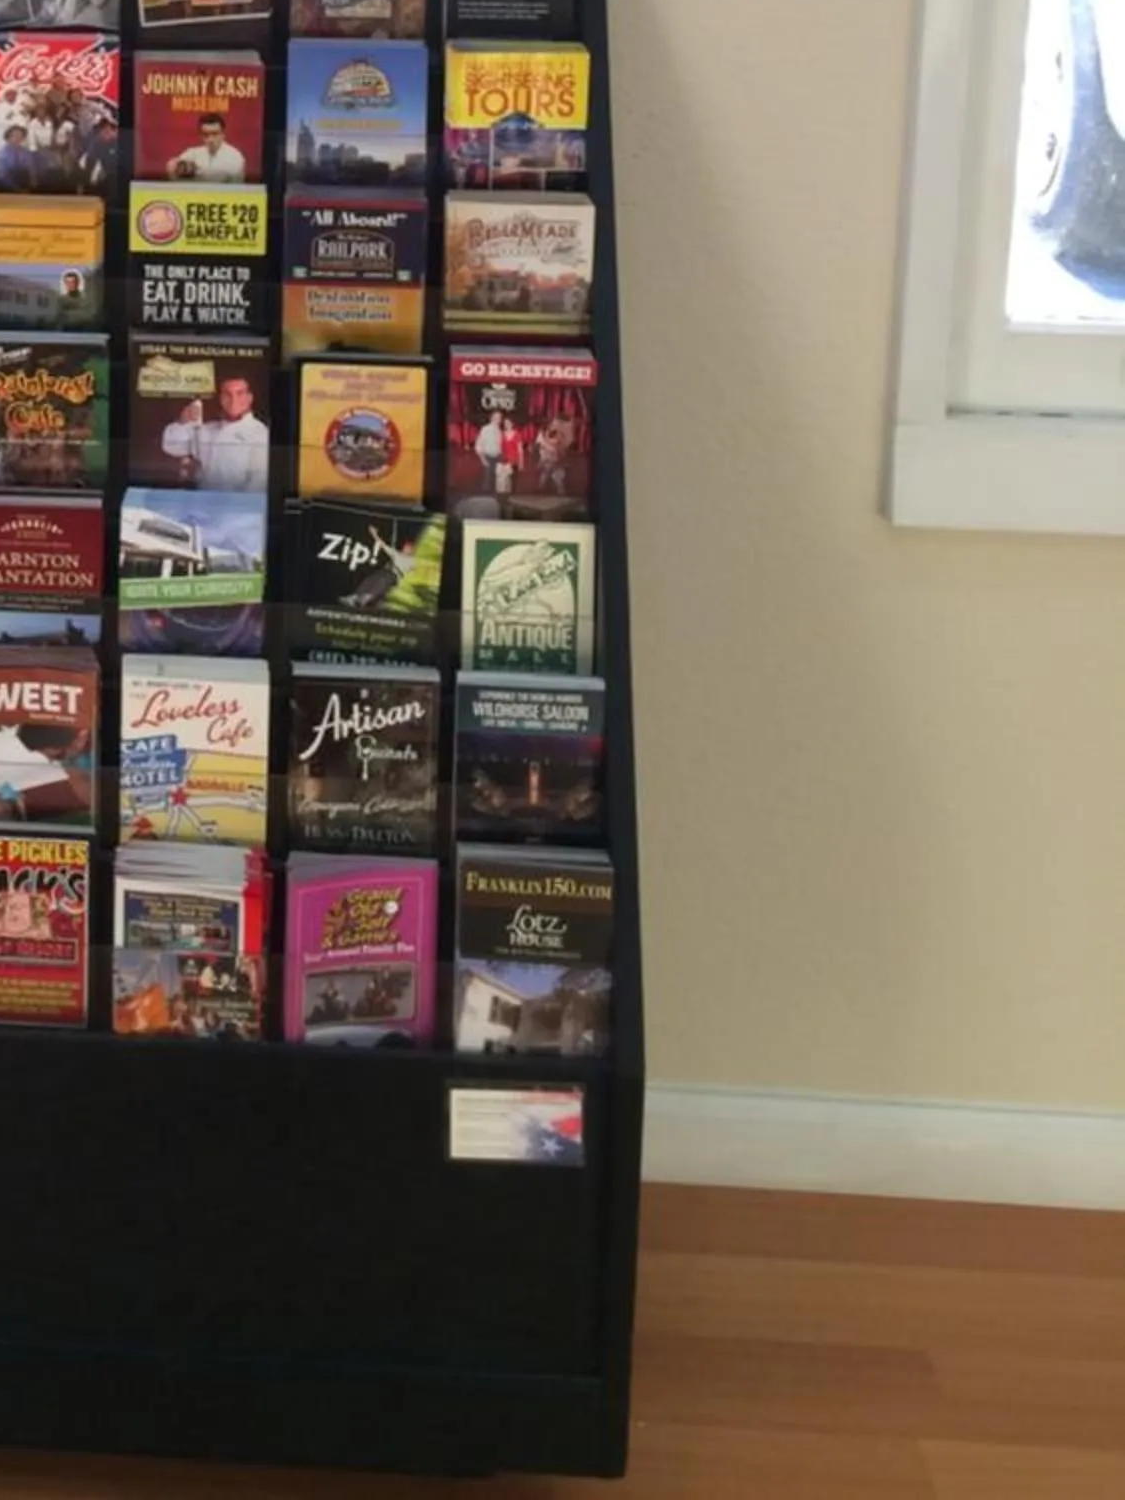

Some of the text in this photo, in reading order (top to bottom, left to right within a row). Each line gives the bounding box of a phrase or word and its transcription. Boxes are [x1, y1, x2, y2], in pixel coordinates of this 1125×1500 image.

[142, 73, 259, 99] JOHNNY CASH
[171, 96, 229, 114] MUSEUM
[465, 88, 575, 118] TOURS
[186, 203, 260, 223] FREE $20
[185, 223, 259, 242] GAMEPLAY
[317, 240, 388, 260] RAILPARK
[144, 264, 251, 281] THE ONLY PLACE TO
[142, 306, 178, 324] PLAY
[182, 307, 194, 324] &
[460, 362, 592, 380] GO BACKSTAGE!
[318, 531, 379, 570] Zip!
[480, 617, 573, 651] ANTIQUE
[131, 686, 242, 729] Loveless
[472, 701, 589, 722] WILDHORSE SALOON
[206, 716, 255, 747] Cafe
[299, 691, 426, 761] Artisan
[122, 736, 172, 754] CAFE
[8, 840, 89, 866] PICKLES
[466, 871, 612, 899] FRANKLIN150.COM
